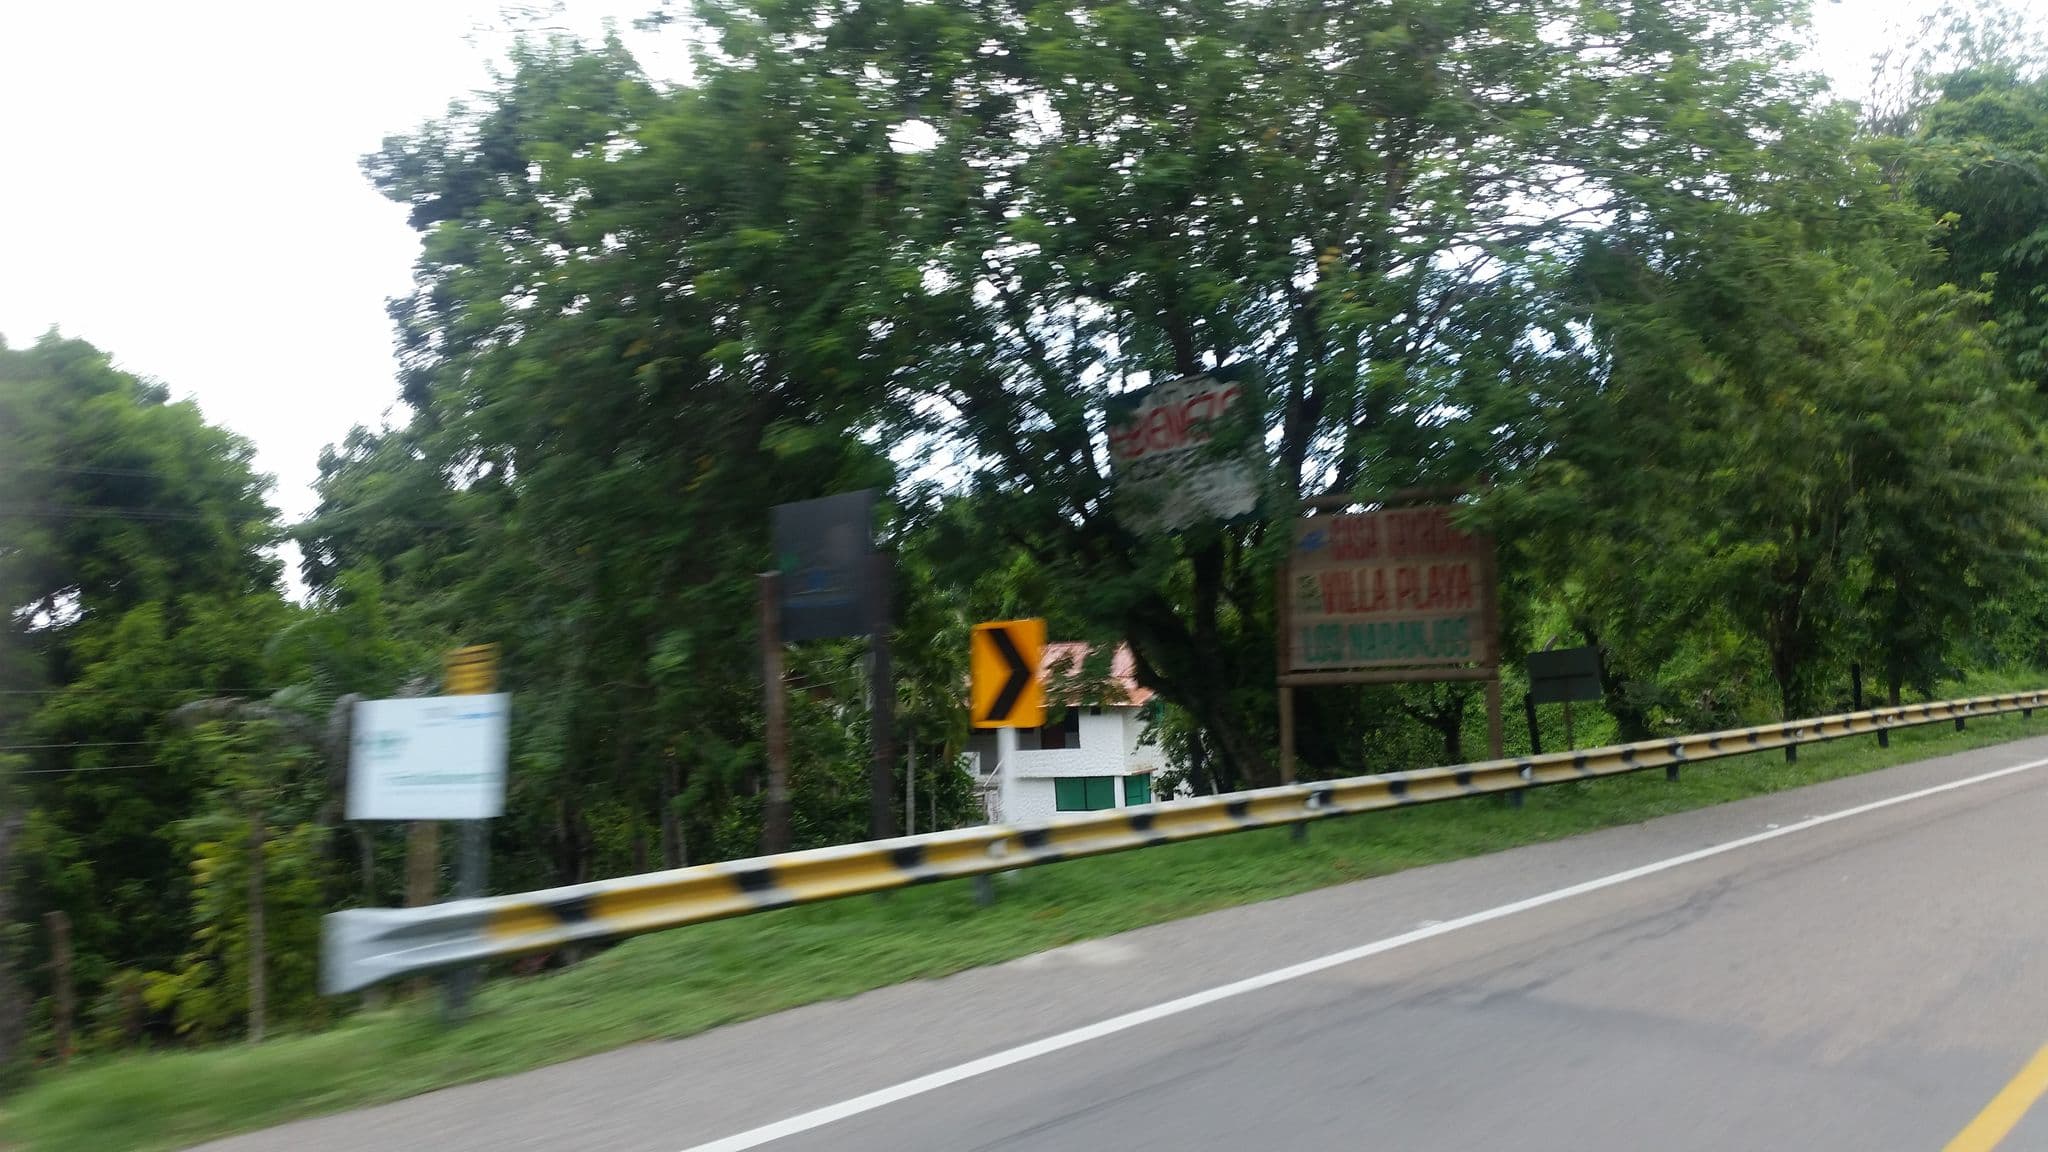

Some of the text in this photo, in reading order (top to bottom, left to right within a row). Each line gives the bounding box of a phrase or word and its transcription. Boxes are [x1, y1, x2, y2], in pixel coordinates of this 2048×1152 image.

[1319, 563, 1473, 615] VILLA PLAYA
[1301, 616, 1472, 663] LOS NARANJOS
